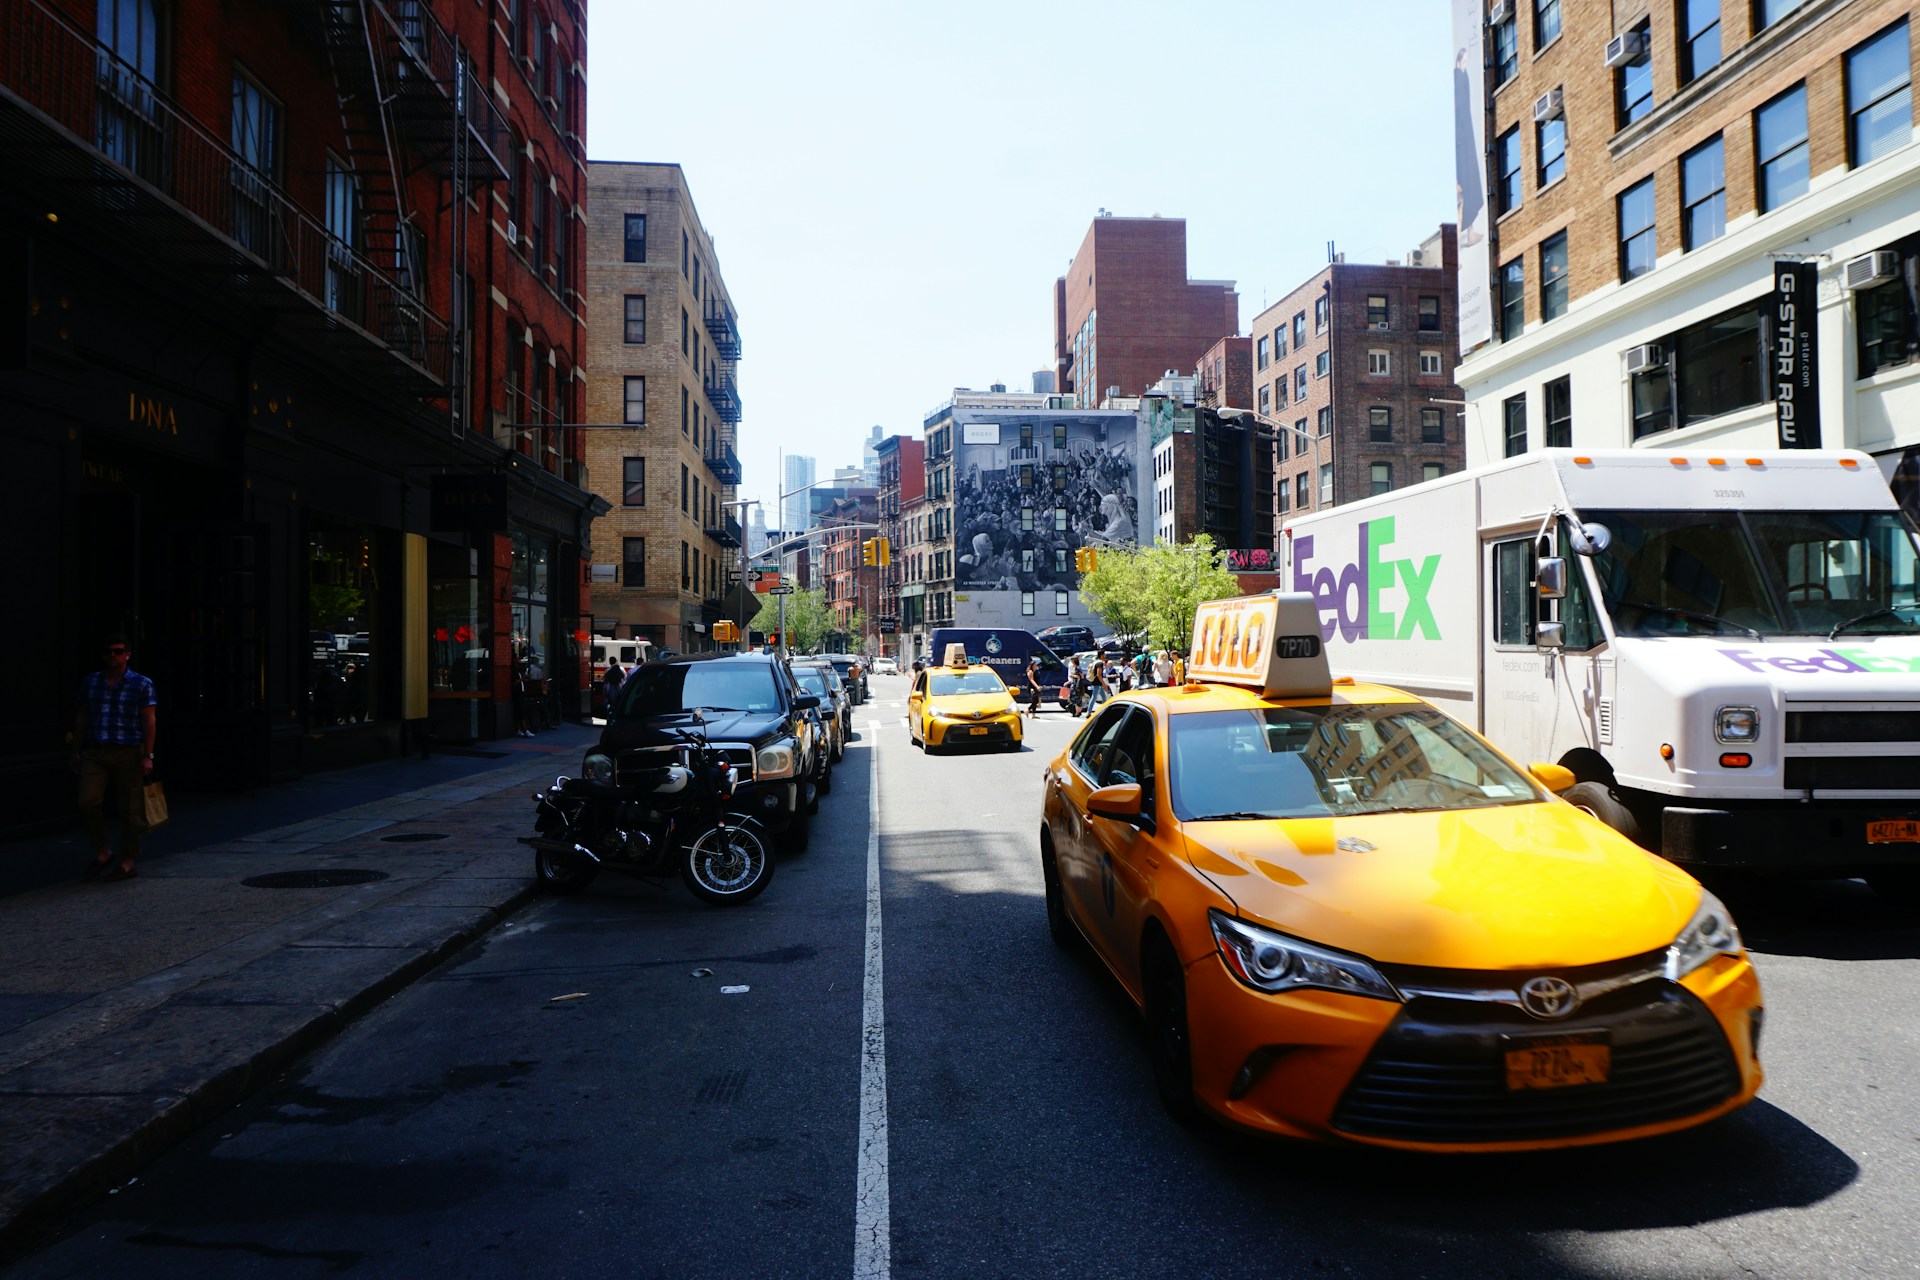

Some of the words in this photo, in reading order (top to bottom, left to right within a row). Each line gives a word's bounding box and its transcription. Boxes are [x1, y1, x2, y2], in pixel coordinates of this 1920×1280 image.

[1800, 332, 1810, 388] g-star.com
[129, 393, 178, 435] DNA
[1778, 383, 1797, 442] RAW
[1294, 516, 1442, 644] FedEx
[1195, 612, 1266, 669] SOLO
[1281, 638, 1311, 656] 7P70
[1502, 658, 1540, 672] fedex.com
